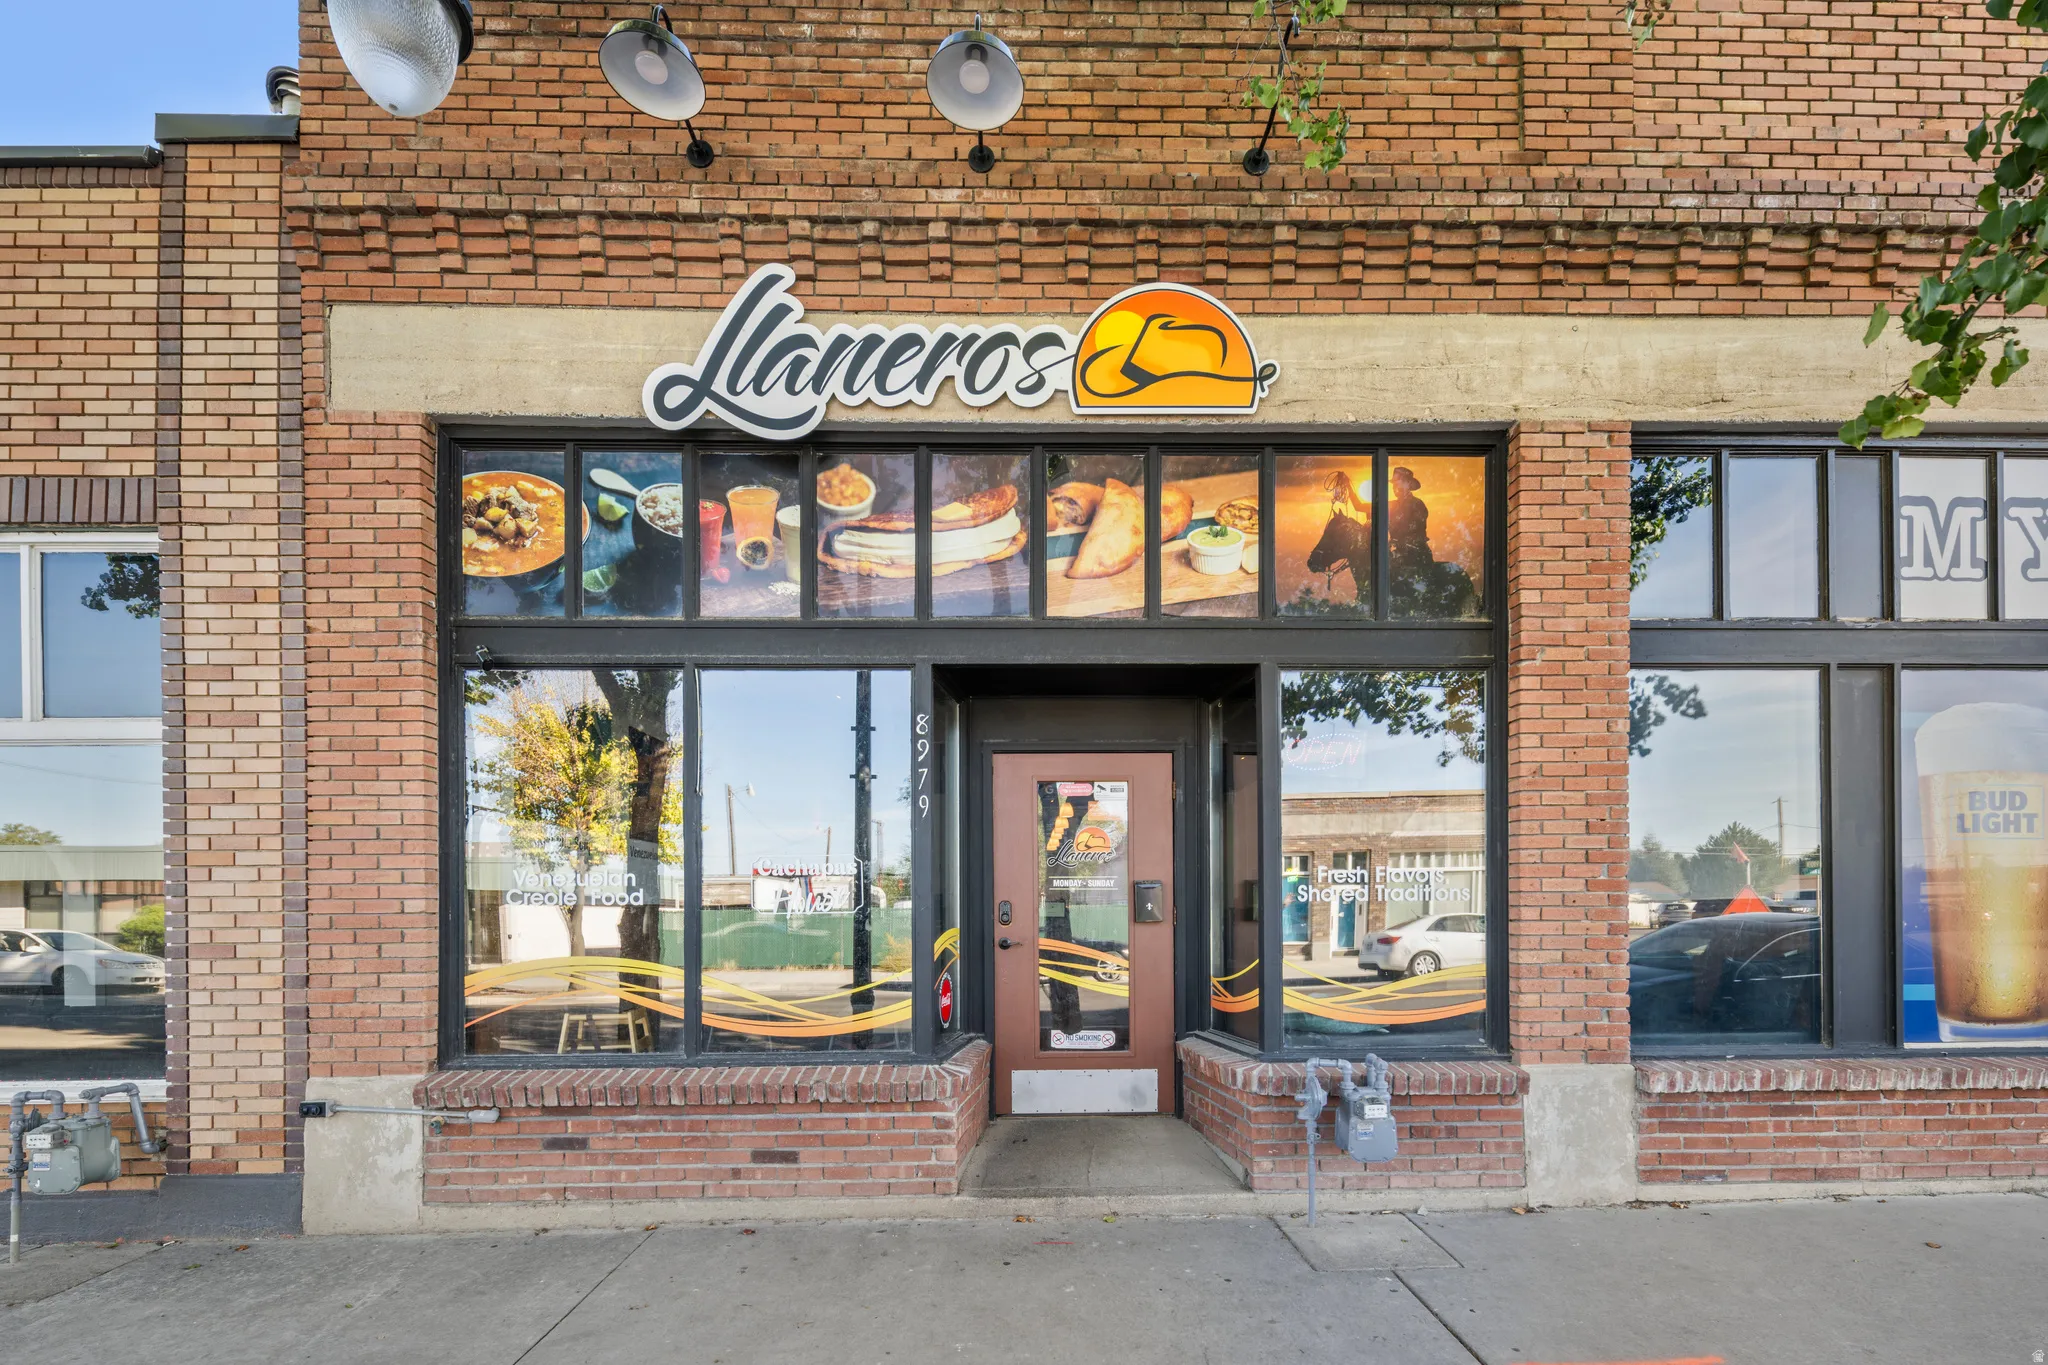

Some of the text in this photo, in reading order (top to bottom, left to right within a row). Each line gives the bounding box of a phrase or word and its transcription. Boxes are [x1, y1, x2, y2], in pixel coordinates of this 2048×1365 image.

[653, 273, 1076, 430] Llaneros
[1287, 740, 1361, 766] OPEN
[916, 714, 930, 818] 8979
[1969, 791, 2028, 811] BUD
[1957, 812, 2039, 833] LIGHT
[1047, 839, 1116, 868] Llaneros
[513, 869, 636, 887] Venezuelan
[758, 858, 857, 878] Cachapas
[1317, 865, 1368, 883] Fresh
[506, 888, 644, 906] Creole Food
[1297, 884, 1471, 902] Shared Traditions
